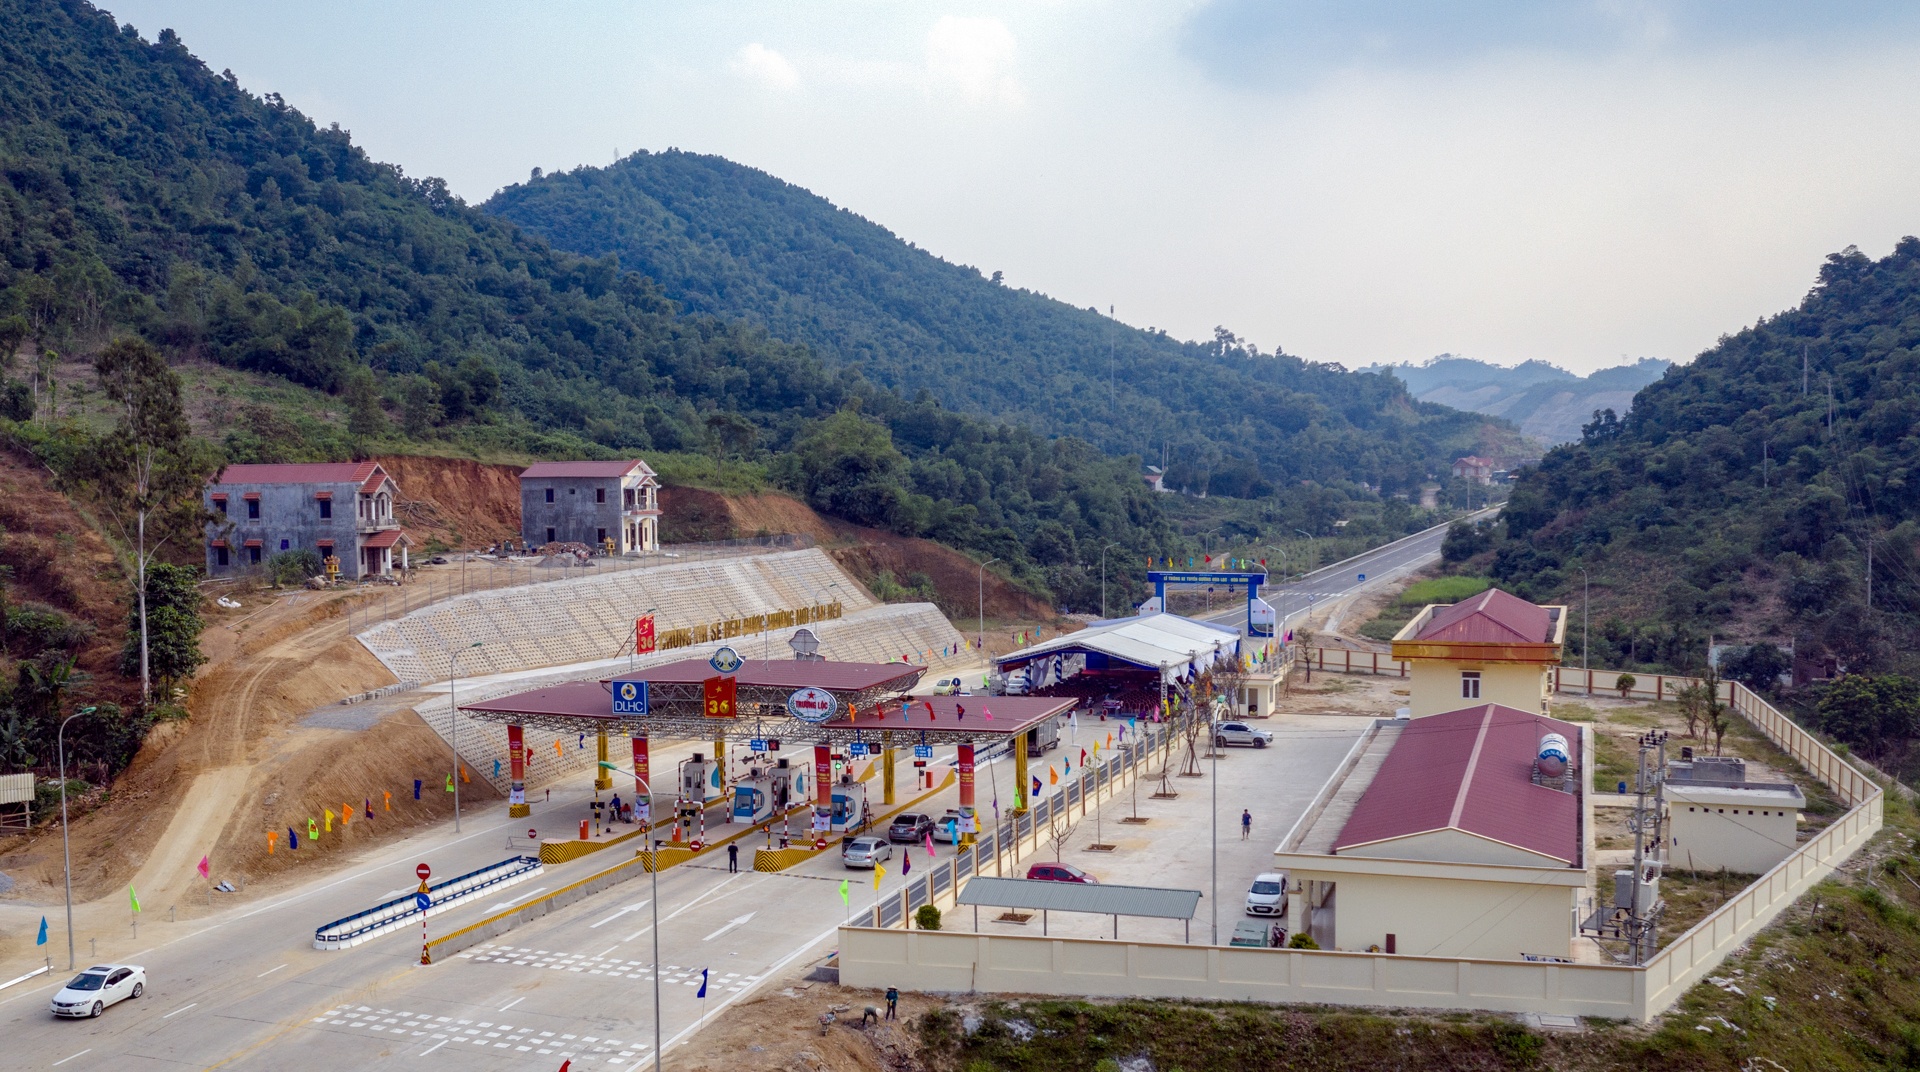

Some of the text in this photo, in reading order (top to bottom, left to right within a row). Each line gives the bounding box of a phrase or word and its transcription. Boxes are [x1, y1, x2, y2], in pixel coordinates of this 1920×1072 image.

[640, 635, 654, 650] 36
[658, 624, 692, 650] CHÚNG
[614, 700, 644, 712] DLHC
[708, 699, 730, 714] 36
[795, 699, 829, 712] TRƯỜNG LỘC
